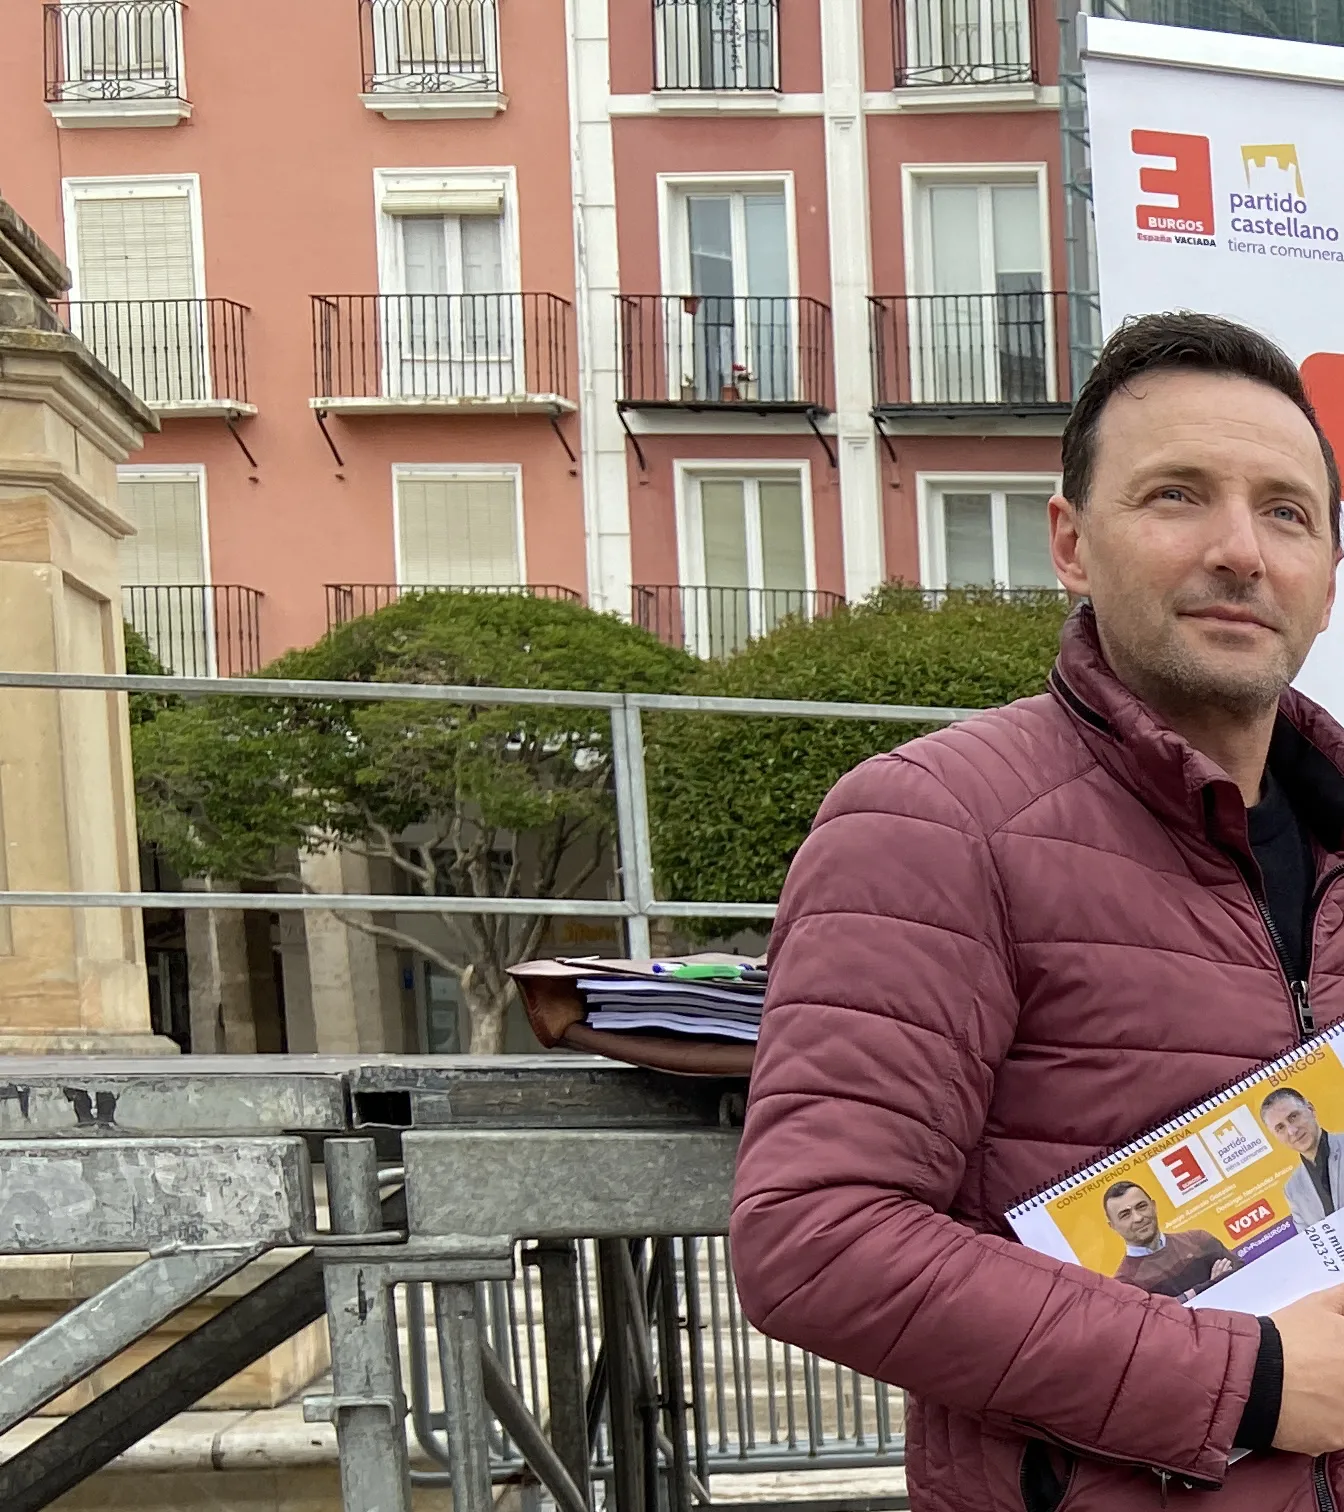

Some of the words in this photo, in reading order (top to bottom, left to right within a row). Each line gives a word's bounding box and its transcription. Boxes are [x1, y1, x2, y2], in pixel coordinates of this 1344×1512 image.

[1230, 193, 1307, 214] partido
[1148, 217, 1203, 232] BURGOS
[1231, 217, 1339, 242] castellano
[1175, 236, 1216, 247] VACIADA
[1228, 238, 1266, 255] tierra
[1270, 245, 1344, 262] comunera
[1268, 1047, 1326, 1088] BURGOS
[1217, 1135, 1247, 1157] partido
[1222, 1138, 1262, 1165] castellano
[1056, 1164, 1131, 1210] CONSTRUYENDO
[1133, 1128, 1192, 1166] ALTERNATIVA
[1229, 1205, 1271, 1233] VOTA
